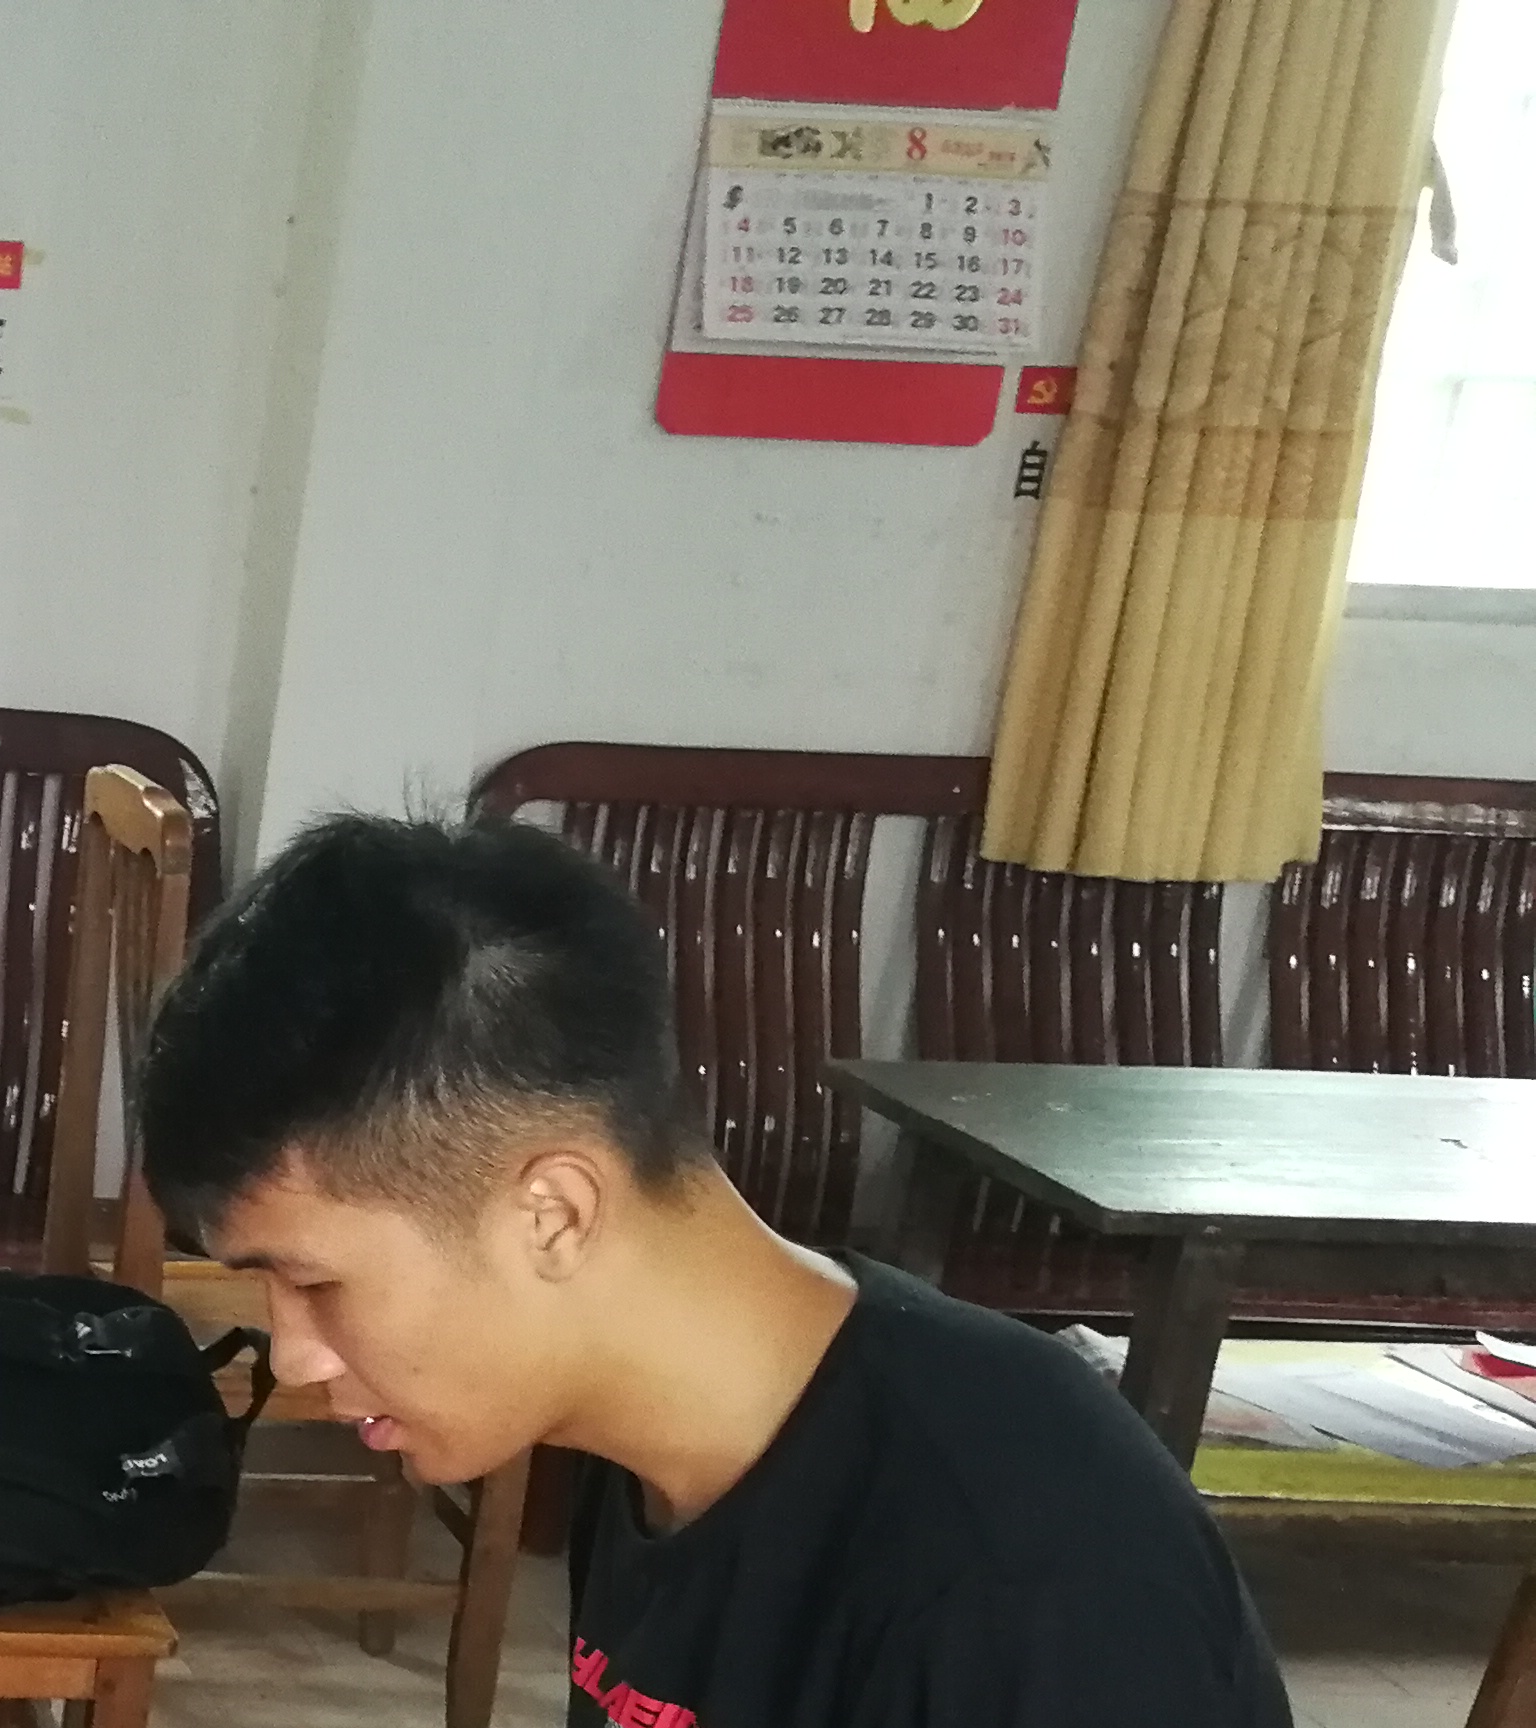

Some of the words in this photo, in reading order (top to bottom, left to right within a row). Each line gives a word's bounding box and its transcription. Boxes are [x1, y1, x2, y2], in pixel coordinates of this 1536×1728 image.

[906, 126, 927, 161] 8
[926, 193, 934, 210] 1
[966, 196, 978, 214] 2
[783, 217, 797, 234] 5
[829, 218, 845, 236] 6
[877, 219, 890, 237] 7
[920, 221, 933, 239] 8
[964, 225, 976, 244] 9
[1002, 228, 1027, 246] 10
[777, 246, 802, 265] 12
[822, 247, 849, 265] 13
[870, 248, 893, 267] 14
[914, 251, 937, 270] 15
[956, 255, 981, 273] 16
[1001, 257, 1024, 276] 17
[819, 277, 848, 296] 20
[868, 278, 892, 296] 21
[910, 280, 936, 299] 22
[954, 284, 980, 303] 23
[818, 306, 846, 325] 27
[953, 314, 979, 332] 30
[997, 317, 1020, 334] 31
